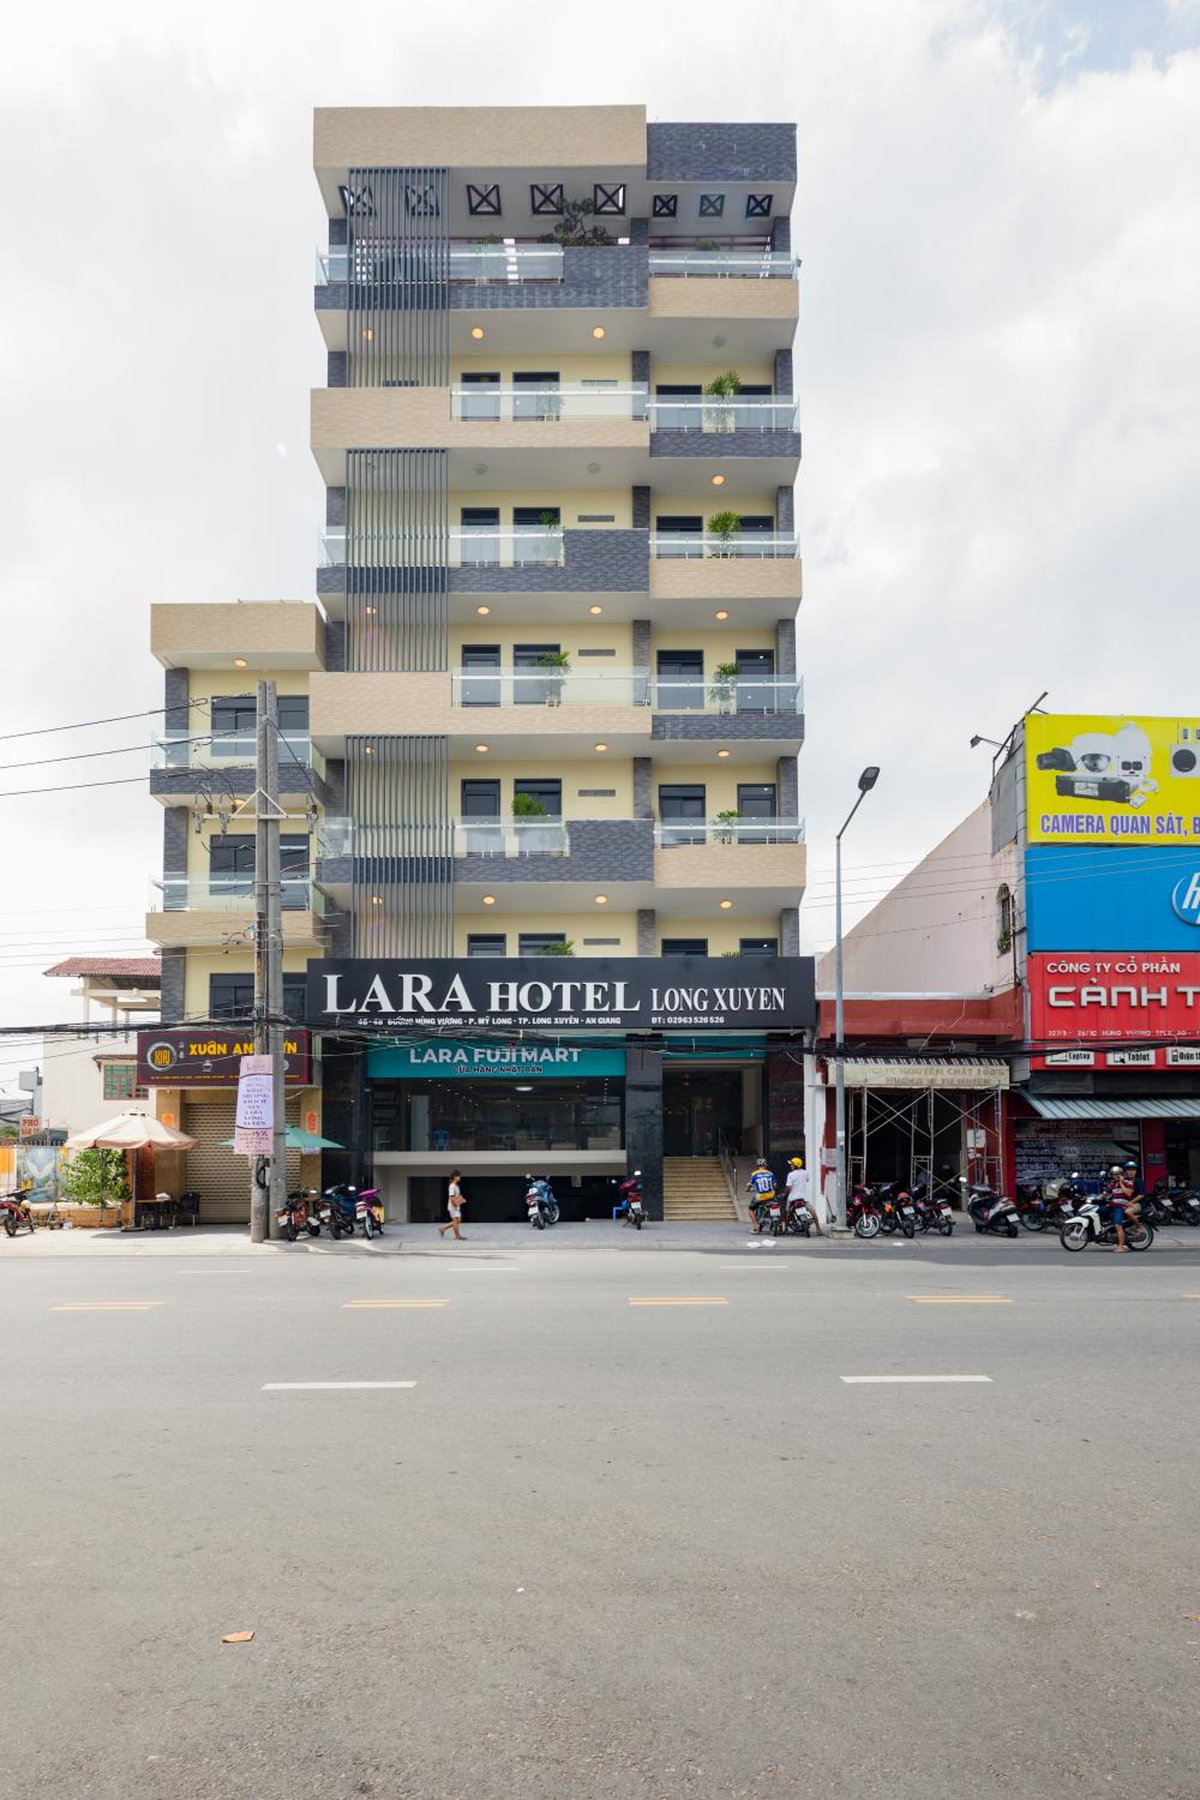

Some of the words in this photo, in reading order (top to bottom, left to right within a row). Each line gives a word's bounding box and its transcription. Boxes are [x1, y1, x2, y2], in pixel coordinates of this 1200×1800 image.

[1041, 815, 1106, 834] CAMERA
[1110, 815, 1151, 836] QUAN
[1047, 960, 1091, 974] CÔNG
[1095, 962, 1111, 973] TY
[1115, 956, 1138, 974] CỔ
[1142, 956, 1181, 974] PHẦN
[322, 972, 476, 1013] LARA
[486, 981, 641, 1013] HOTEL
[650, 988, 710, 1012] LONG
[713, 987, 786, 1011] XUYEN
[1048, 977, 1168, 1007] CẢNH
[478, 1015, 490, 1025] MỸ
[492, 1017, 513, 1025] LONG
[518, 1017, 531, 1025] TP.
[532, 1017, 552, 1025] LONG
[554, 1016, 580, 1025] XUYÊN
[585, 1017, 596, 1025] AN
[598, 1017, 621, 1025] GIANG
[189, 1041, 228, 1056] XUÂN
[409, 1048, 469, 1063] LARA
[473, 1047, 517, 1063] FUJI
[521, 1046, 582, 1063] MART
